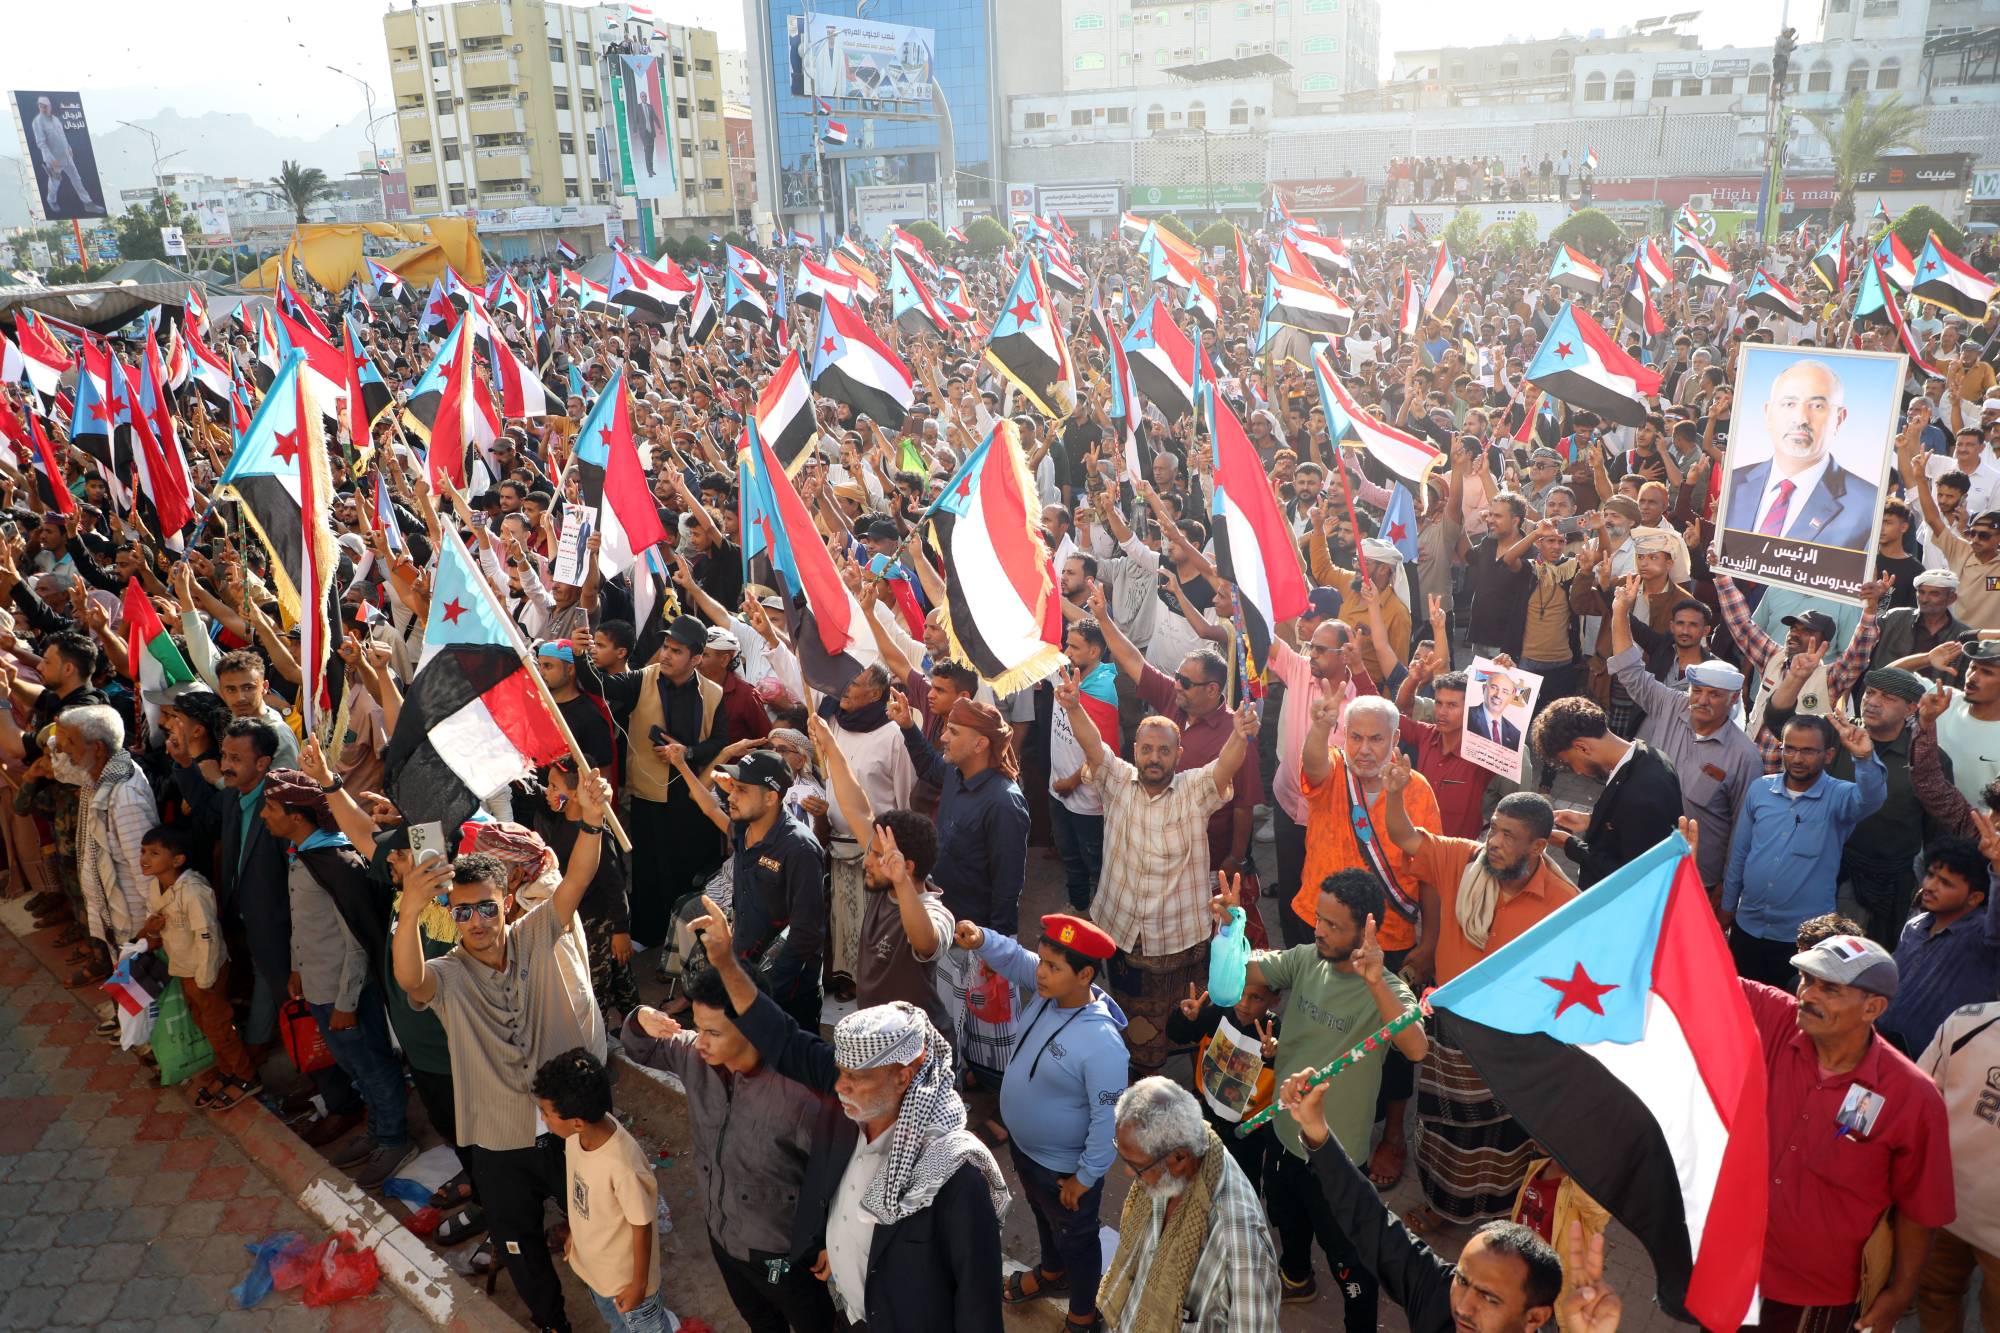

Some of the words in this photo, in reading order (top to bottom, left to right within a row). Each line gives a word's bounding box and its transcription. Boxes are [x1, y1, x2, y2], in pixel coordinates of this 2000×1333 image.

[62, 111, 83, 120] الرجال
[64, 120, 85, 130] للرجال
[1915, 169, 1956, 181] كييف
[1712, 188, 1751, 203] High
[957, 199, 975, 207] ATM
[1773, 546, 1819, 565] الرئيس
[1757, 564, 1792, 578] قاسم
[1793, 569, 1808, 584] بن
[1810, 574, 1863, 593] عيدروس
